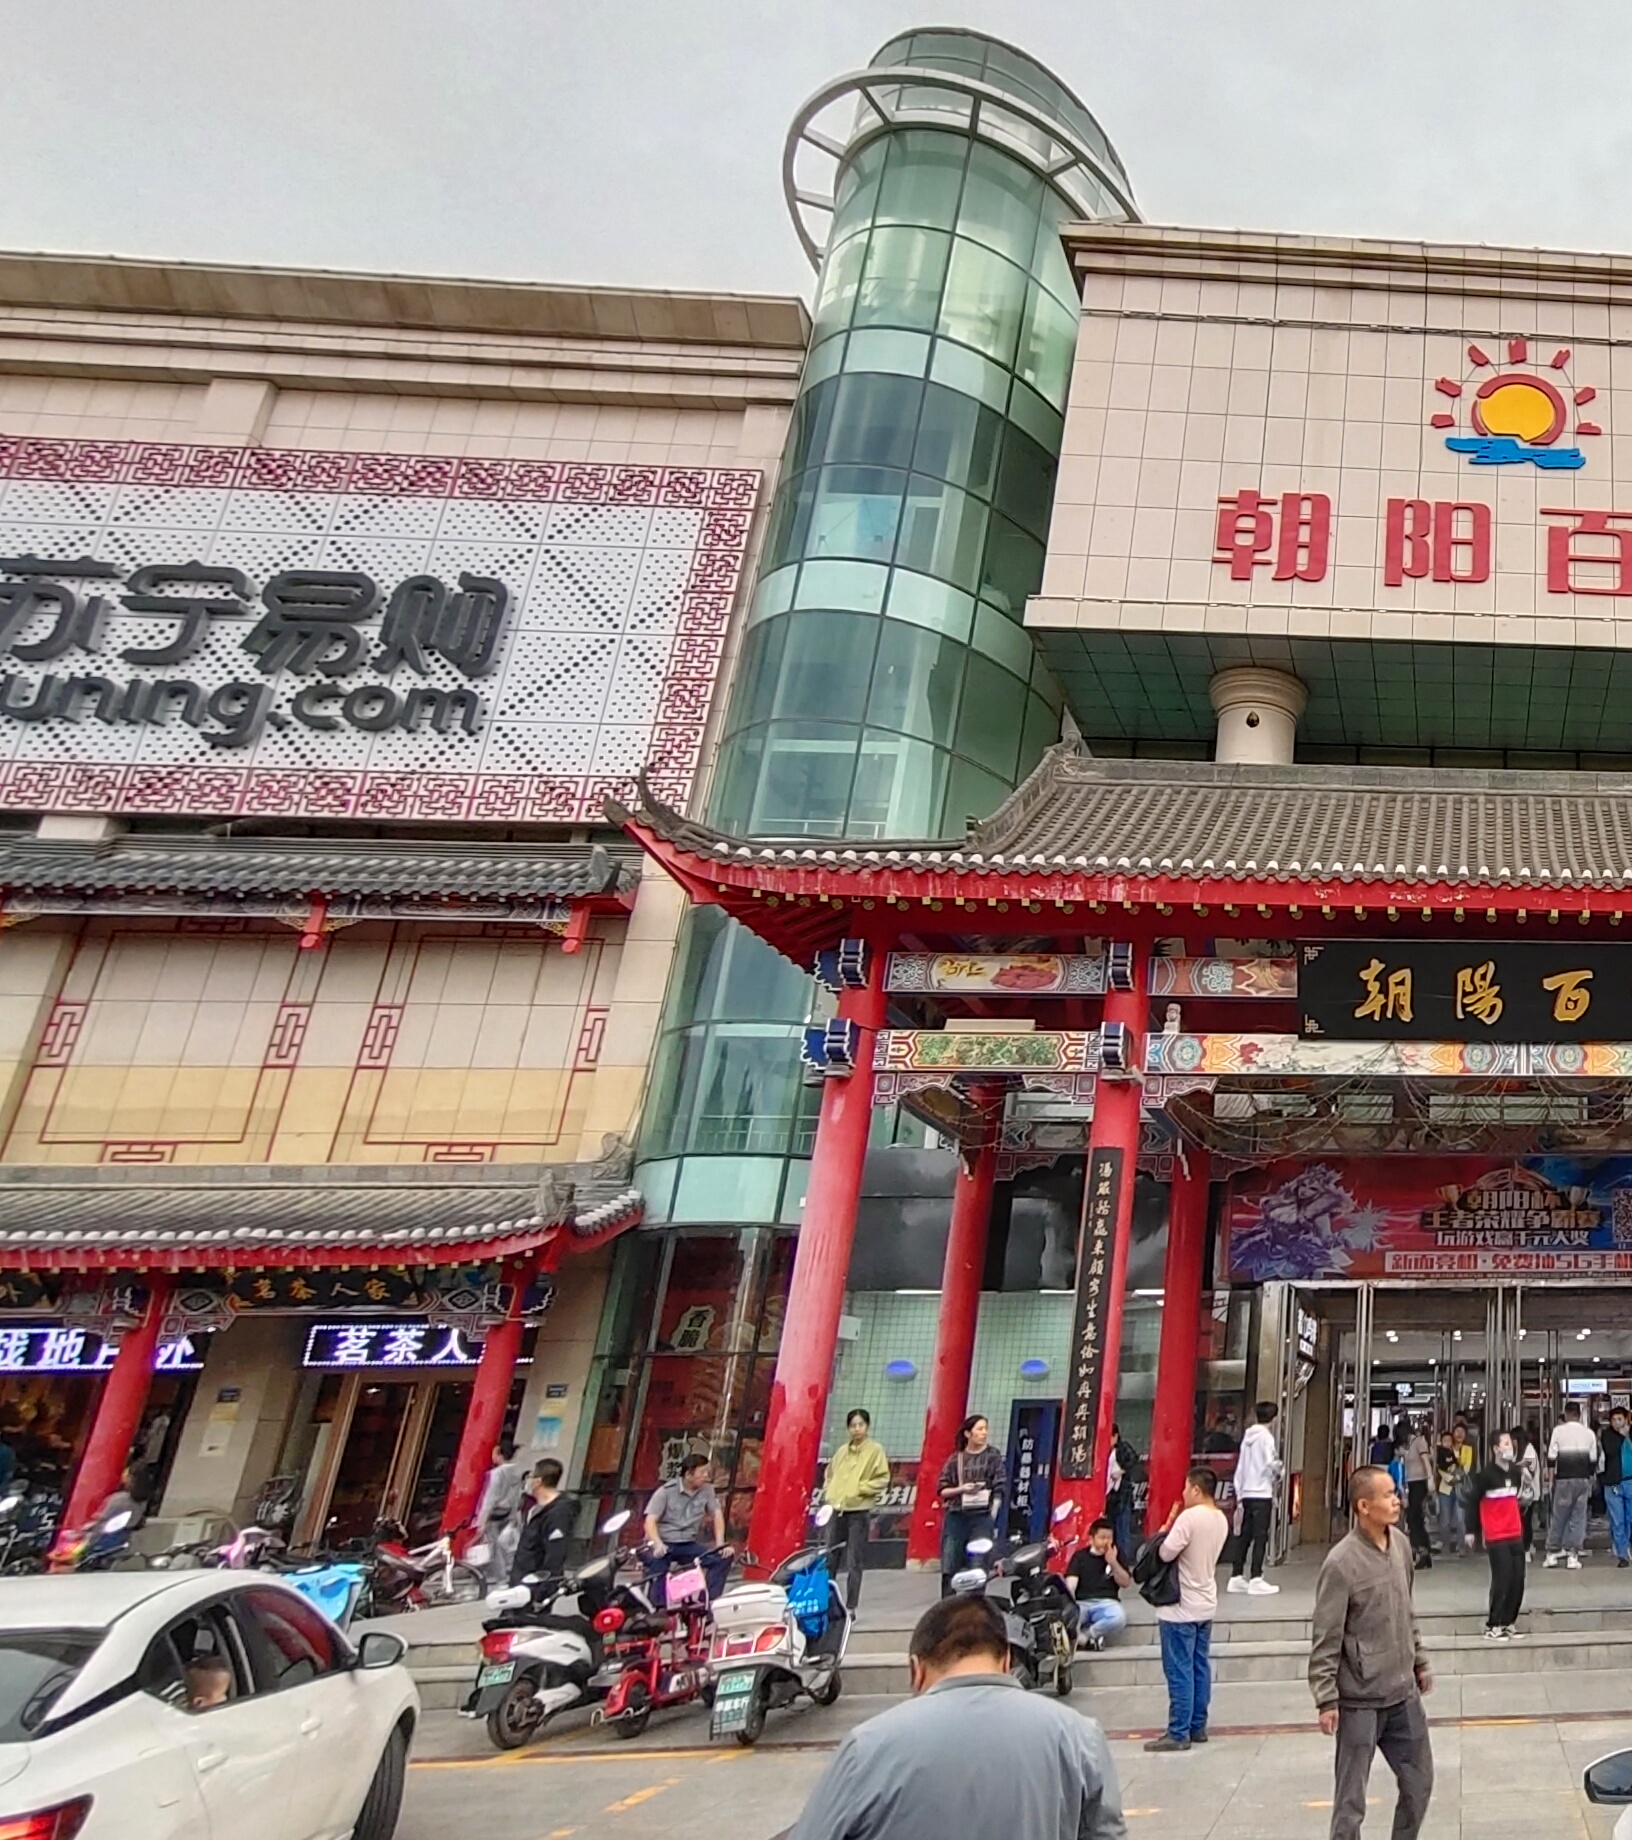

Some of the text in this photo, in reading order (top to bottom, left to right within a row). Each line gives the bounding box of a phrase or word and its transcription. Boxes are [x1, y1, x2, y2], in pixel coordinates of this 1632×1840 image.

[1424, 1210, 1600, 1229] 王者荣耀争霸赛
